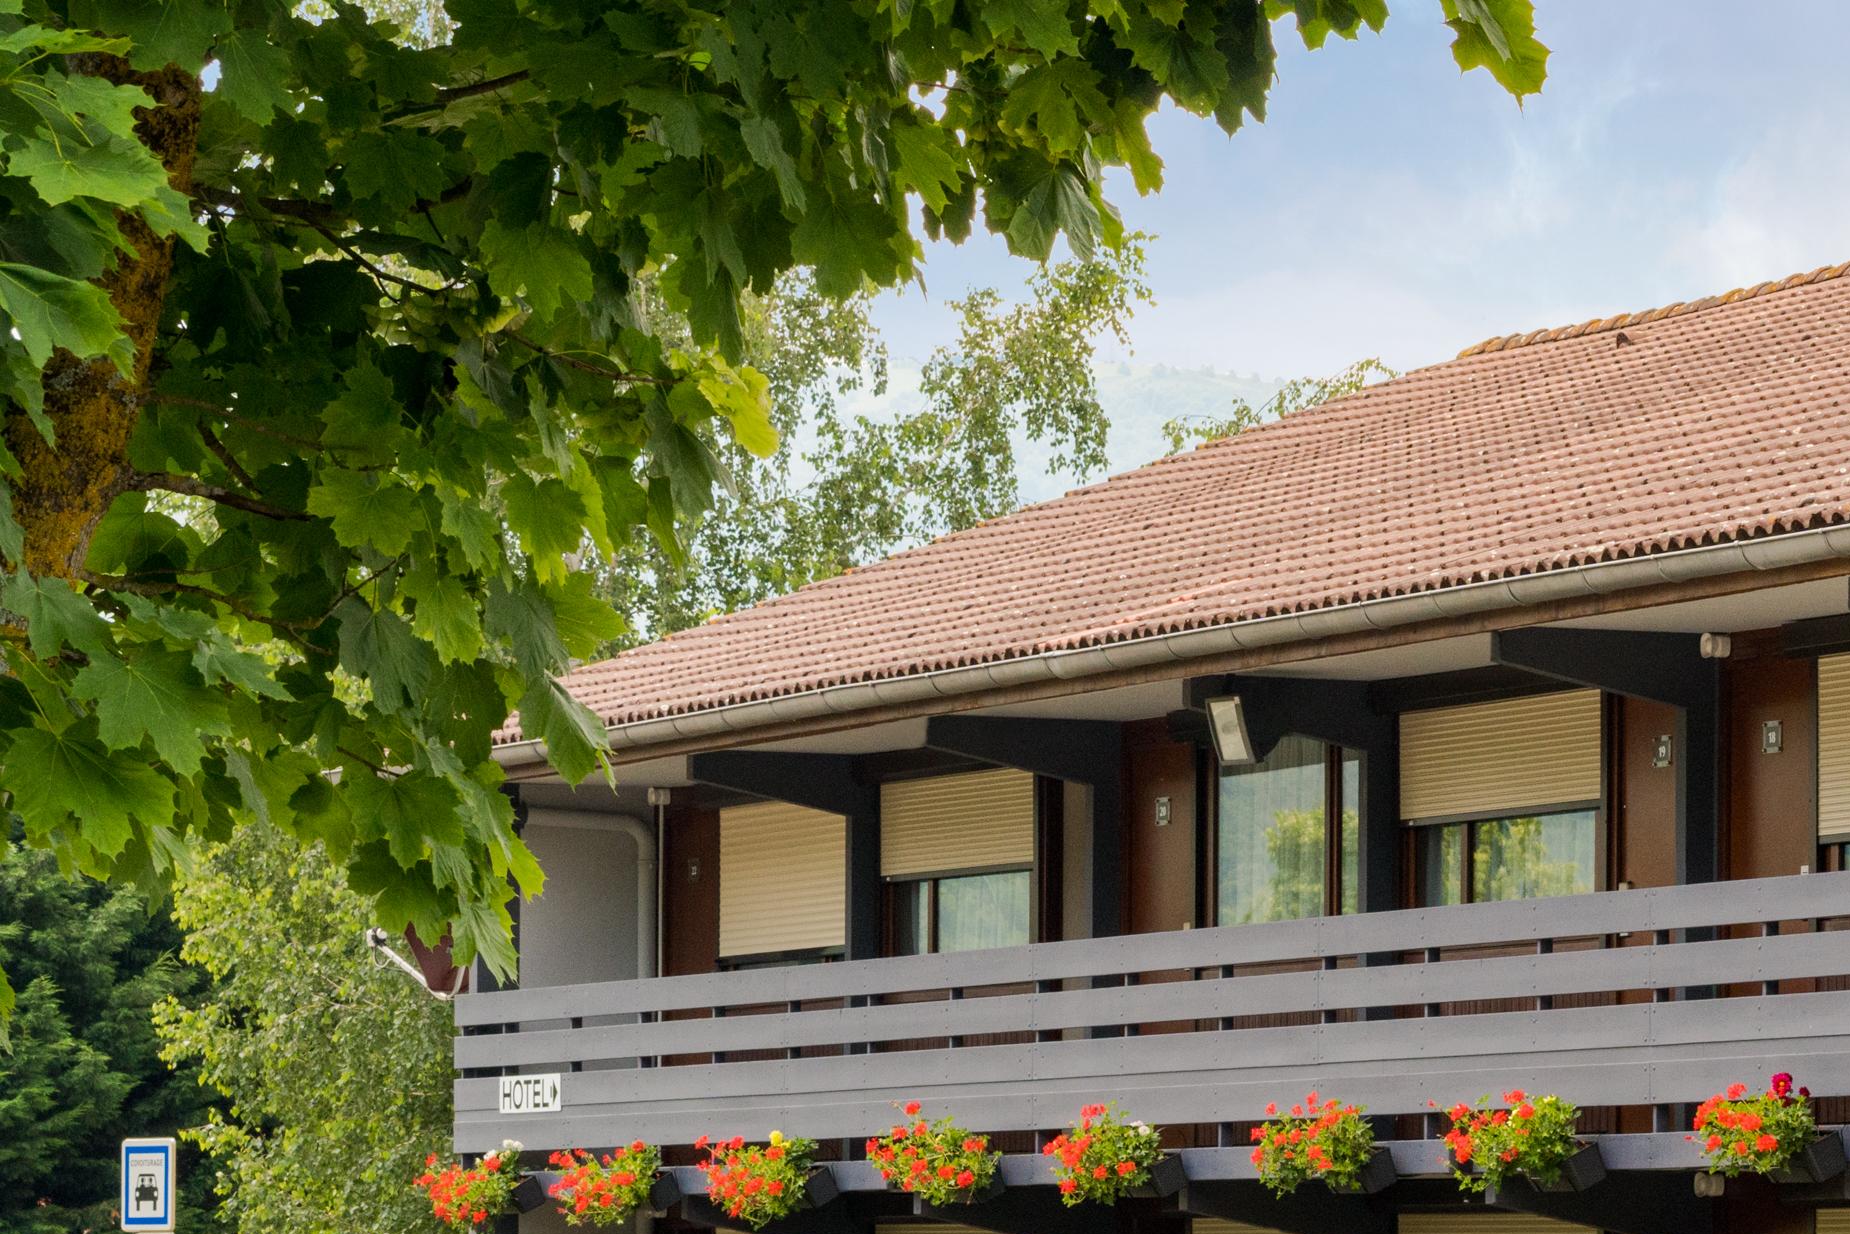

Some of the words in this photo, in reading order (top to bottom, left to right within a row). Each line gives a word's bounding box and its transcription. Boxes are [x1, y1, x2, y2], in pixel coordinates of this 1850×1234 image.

[1768, 731, 1776, 743] 18
[1658, 745, 1666, 758] 19
[502, 1078, 549, 1110] HOTEL
